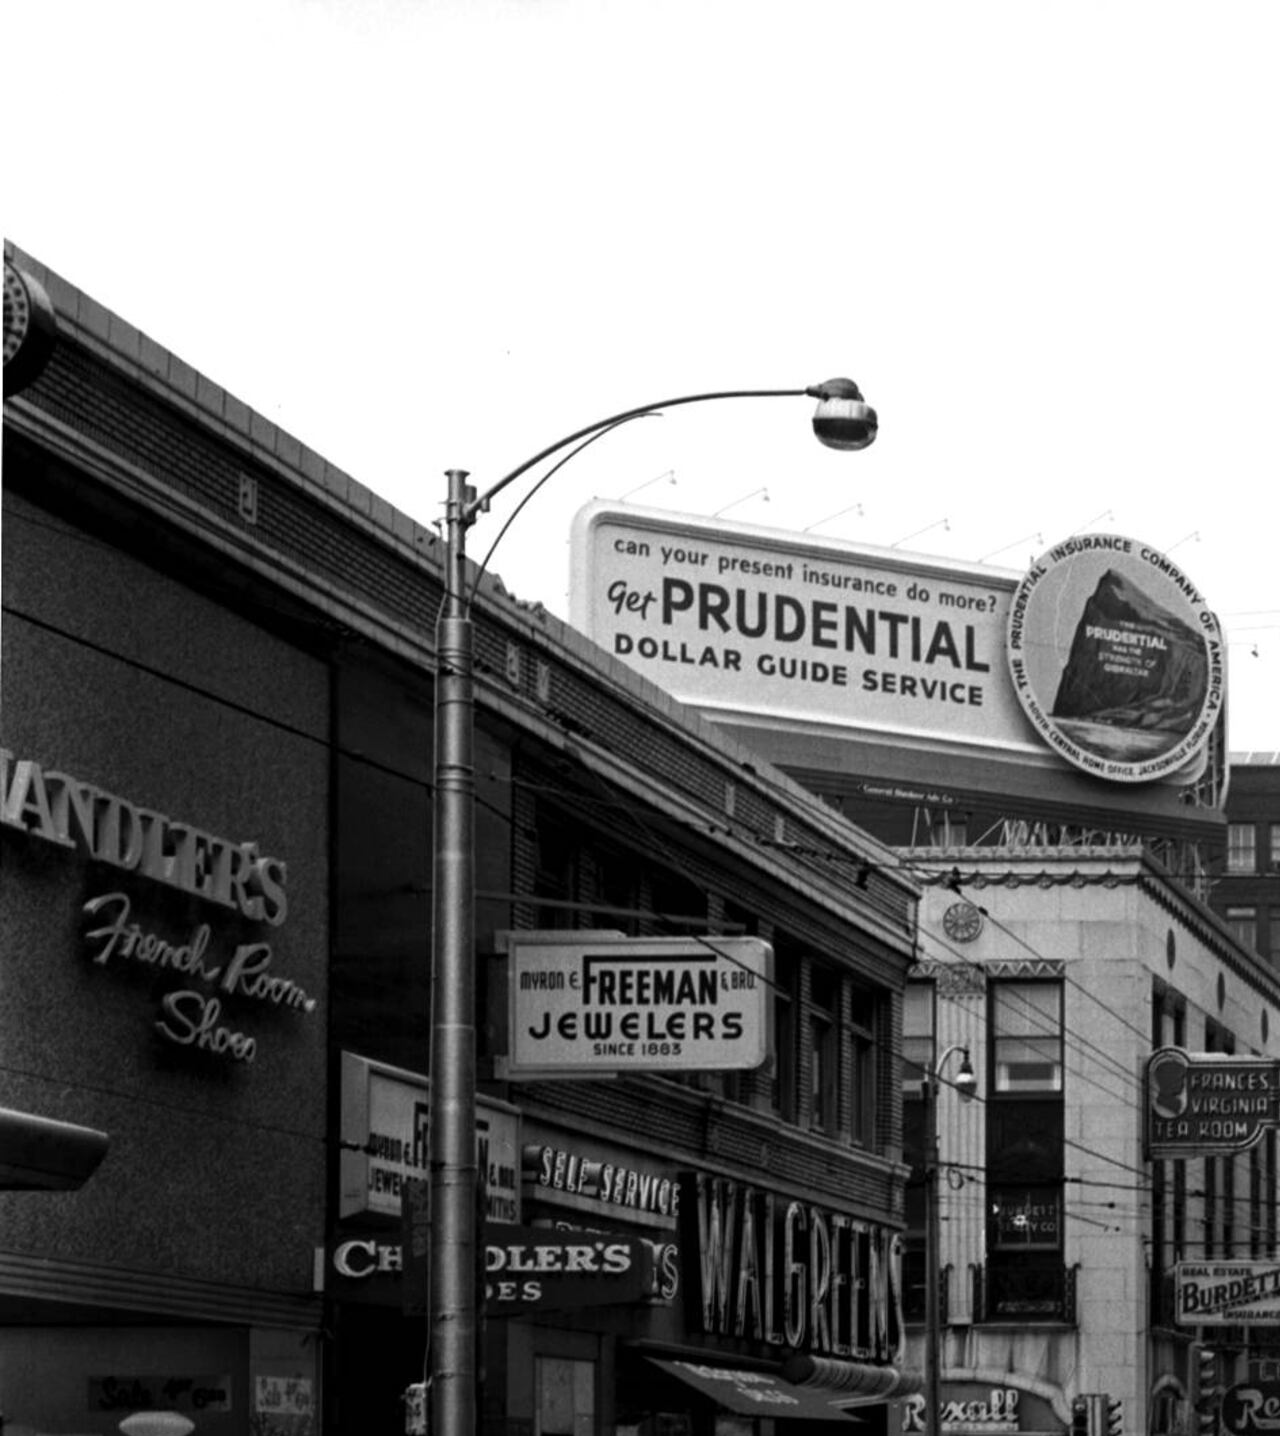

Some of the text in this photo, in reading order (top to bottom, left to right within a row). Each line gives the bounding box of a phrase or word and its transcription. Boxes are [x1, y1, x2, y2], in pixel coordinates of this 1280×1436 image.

[614, 538, 997, 613] can your present insurance do more?
[1049, 536, 1132, 563] INSURANCE
[1140, 547, 1204, 605] COMPANY
[607, 576, 990, 674] Get PRUDENTIAL
[1010, 563, 1048, 650] PRUDENTIAL
[1199, 610, 1216, 634] OF
[1085, 624, 1168, 650] PRUDENTIAL
[614, 632, 983, 707] DOLLAR GUIDE SERVICE
[1207, 639, 1223, 711] AMERICA
[0, 746, 289, 927] ANDLER'S
[520, 970, 564, 990] MYRON
[582, 954, 718, 1006] FREEMAN
[155, 990, 257, 1063] Shoes
[528, 1011, 744, 1040] JEWELERS
[593, 1042, 635, 1056] SINCE
[1190, 1072, 1269, 1090] FRANCES
[1190, 1096, 1268, 1114] VIRGINIA
[1155, 1120, 1248, 1138] TEA ROOM
[600, 1163, 681, 1217] SERVICE
[333, 1239, 632, 1278] CHDLER'S
[696, 1172, 908, 1367] WALGREENS
[901, 1389, 1019, 1431] Rxall
